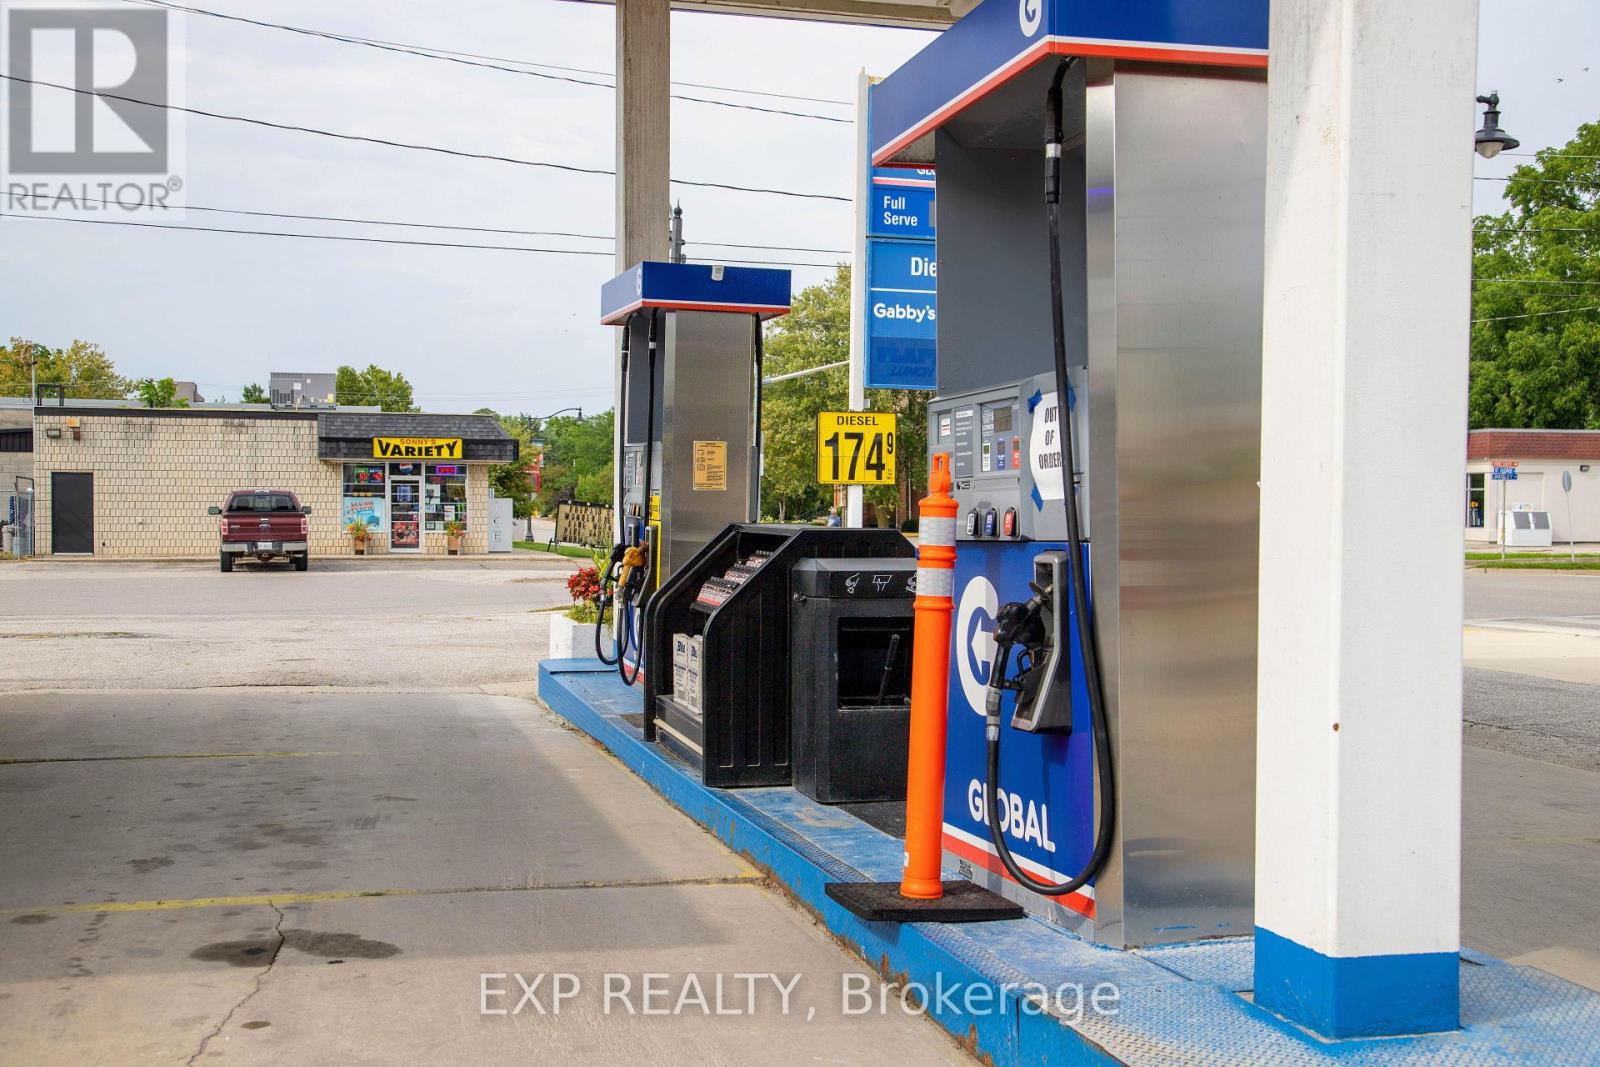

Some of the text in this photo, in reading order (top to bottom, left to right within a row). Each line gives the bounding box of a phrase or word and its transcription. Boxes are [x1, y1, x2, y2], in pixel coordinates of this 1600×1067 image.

[883, 195, 906, 210] Full
[883, 211, 918, 227] Serve
[873, 302, 936, 323] Gabby's
[836, 415, 879, 426] DIESEL
[1044, 406, 1058, 424] OUT
[1044, 429, 1055, 446] OF
[376, 438, 458, 457] VARIETY
[1038, 451, 1063, 470] ORDER
[968, 778, 1056, 853] GLOBAL
